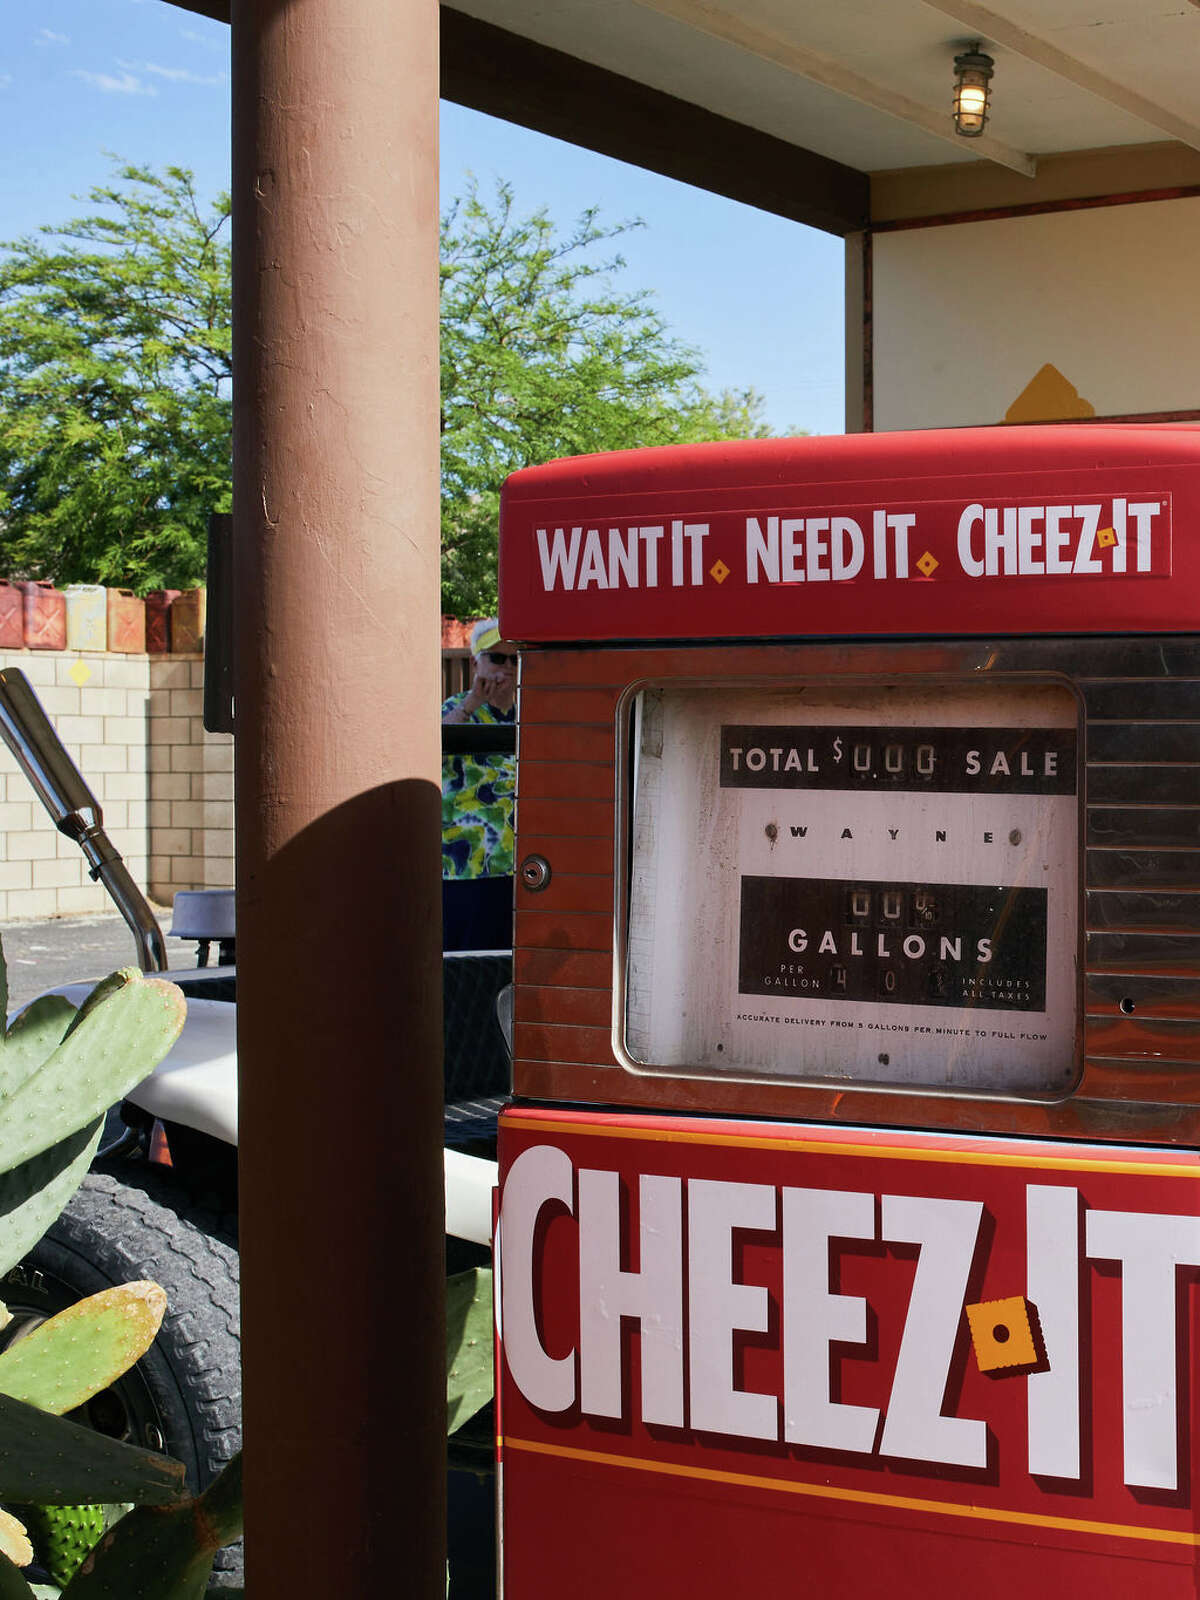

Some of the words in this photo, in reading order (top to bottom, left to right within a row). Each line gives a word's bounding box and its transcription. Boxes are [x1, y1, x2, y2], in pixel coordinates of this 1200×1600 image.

[535, 525, 665, 592] WANT
[746, 516, 865, 584] NEED
[729, 748, 820, 773] TOTAL
[965, 750, 1058, 777] SALE
[787, 928, 993, 964] GALLONS
[780, 963, 805, 975] PER
[763, 976, 821, 990] GALLON
[962, 976, 1031, 989] INCLUDES
[962, 989, 984, 999] ALL
[990, 990, 1031, 1001] TAXES
[736, 1014, 781, 1024] ACCURATE
[784, 1017, 827, 1027] DELIVERY
[830, 1020, 854, 1028] FROM
[868, 1023, 910, 1032] GALLONS
[914, 1025, 932, 1034] PER
[936, 1027, 971, 1036] MINUTE
[991, 1031, 1016, 1039] FULL
[1020, 1033, 1048, 1041] FLOW
